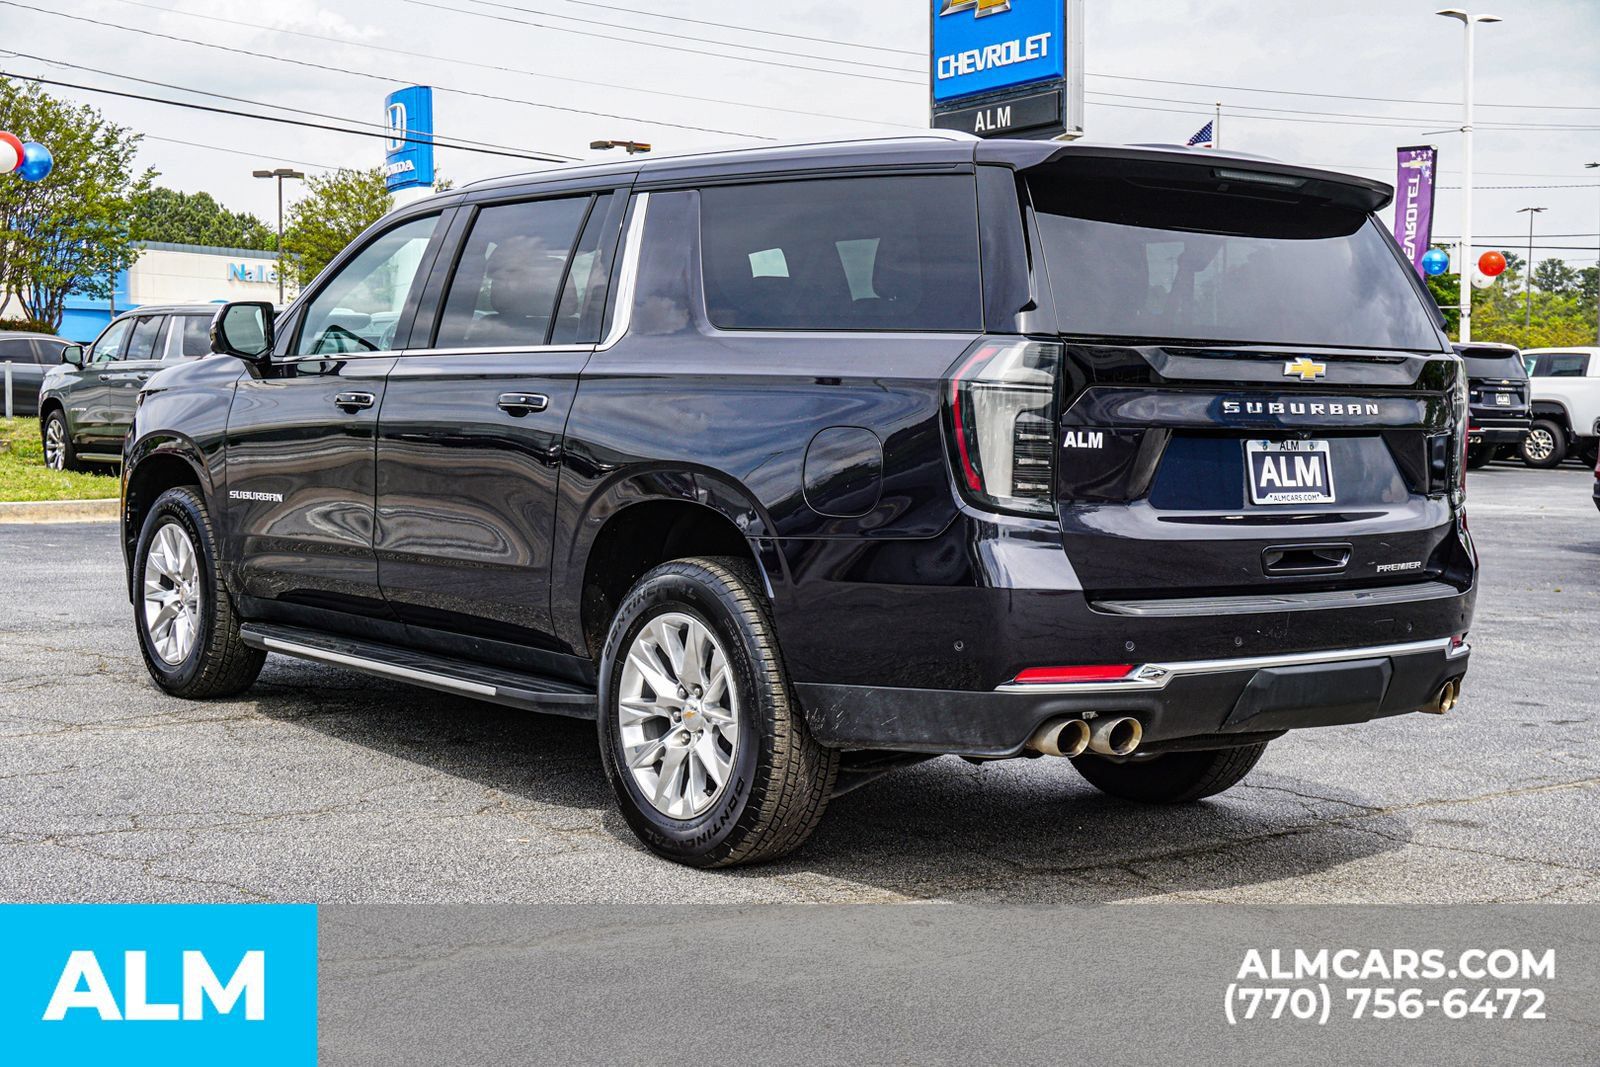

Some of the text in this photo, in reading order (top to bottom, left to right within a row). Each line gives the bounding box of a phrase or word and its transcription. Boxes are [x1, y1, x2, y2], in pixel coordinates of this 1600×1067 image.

[937, 32, 1051, 79] CHEVROLET
[974, 105, 1011, 132] ALM
[1221, 401, 1379, 415] SUBURBAN
[1063, 431, 1103, 449] ALM
[1280, 441, 1300, 451] ALM
[1260, 455, 1322, 487] ALM
[229, 490, 283, 503] SUBURBAN
[1273, 494, 1317, 502] ALMCARS.COM
[1376, 561, 1422, 573] PREMIER
